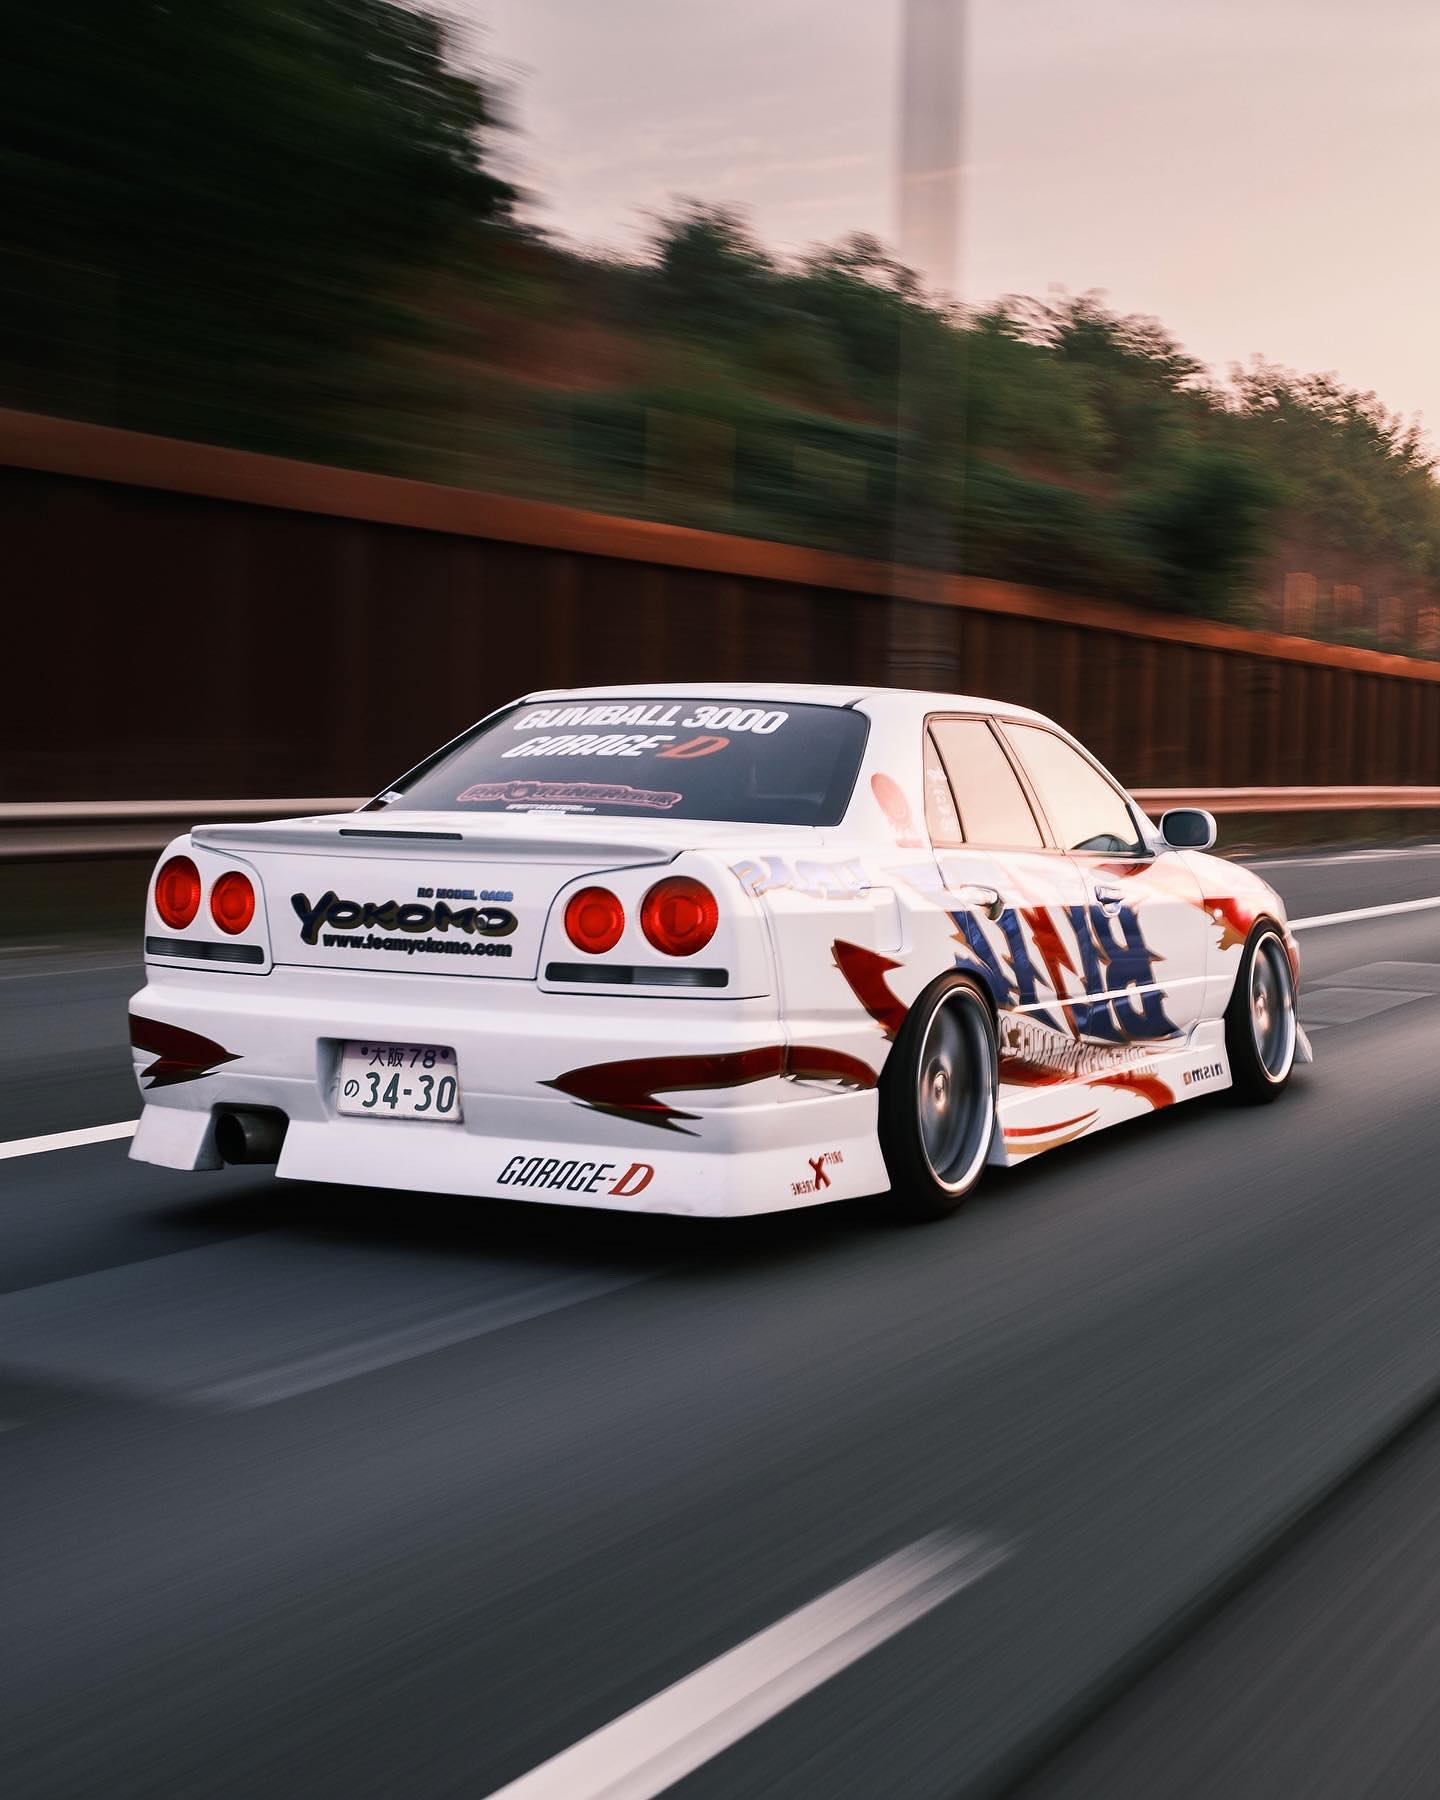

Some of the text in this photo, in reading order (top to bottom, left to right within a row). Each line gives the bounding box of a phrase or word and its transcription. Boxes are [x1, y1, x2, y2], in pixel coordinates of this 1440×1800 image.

[513, 704, 790, 735] GUMBALL 3000
[322, 934, 513, 957] www.teamyokomo.com
[368, 1046, 437, 1069] 大阪 78
[343, 1071, 457, 1114] の 34-30
[496, 1155, 655, 1197] GARAGE-D
